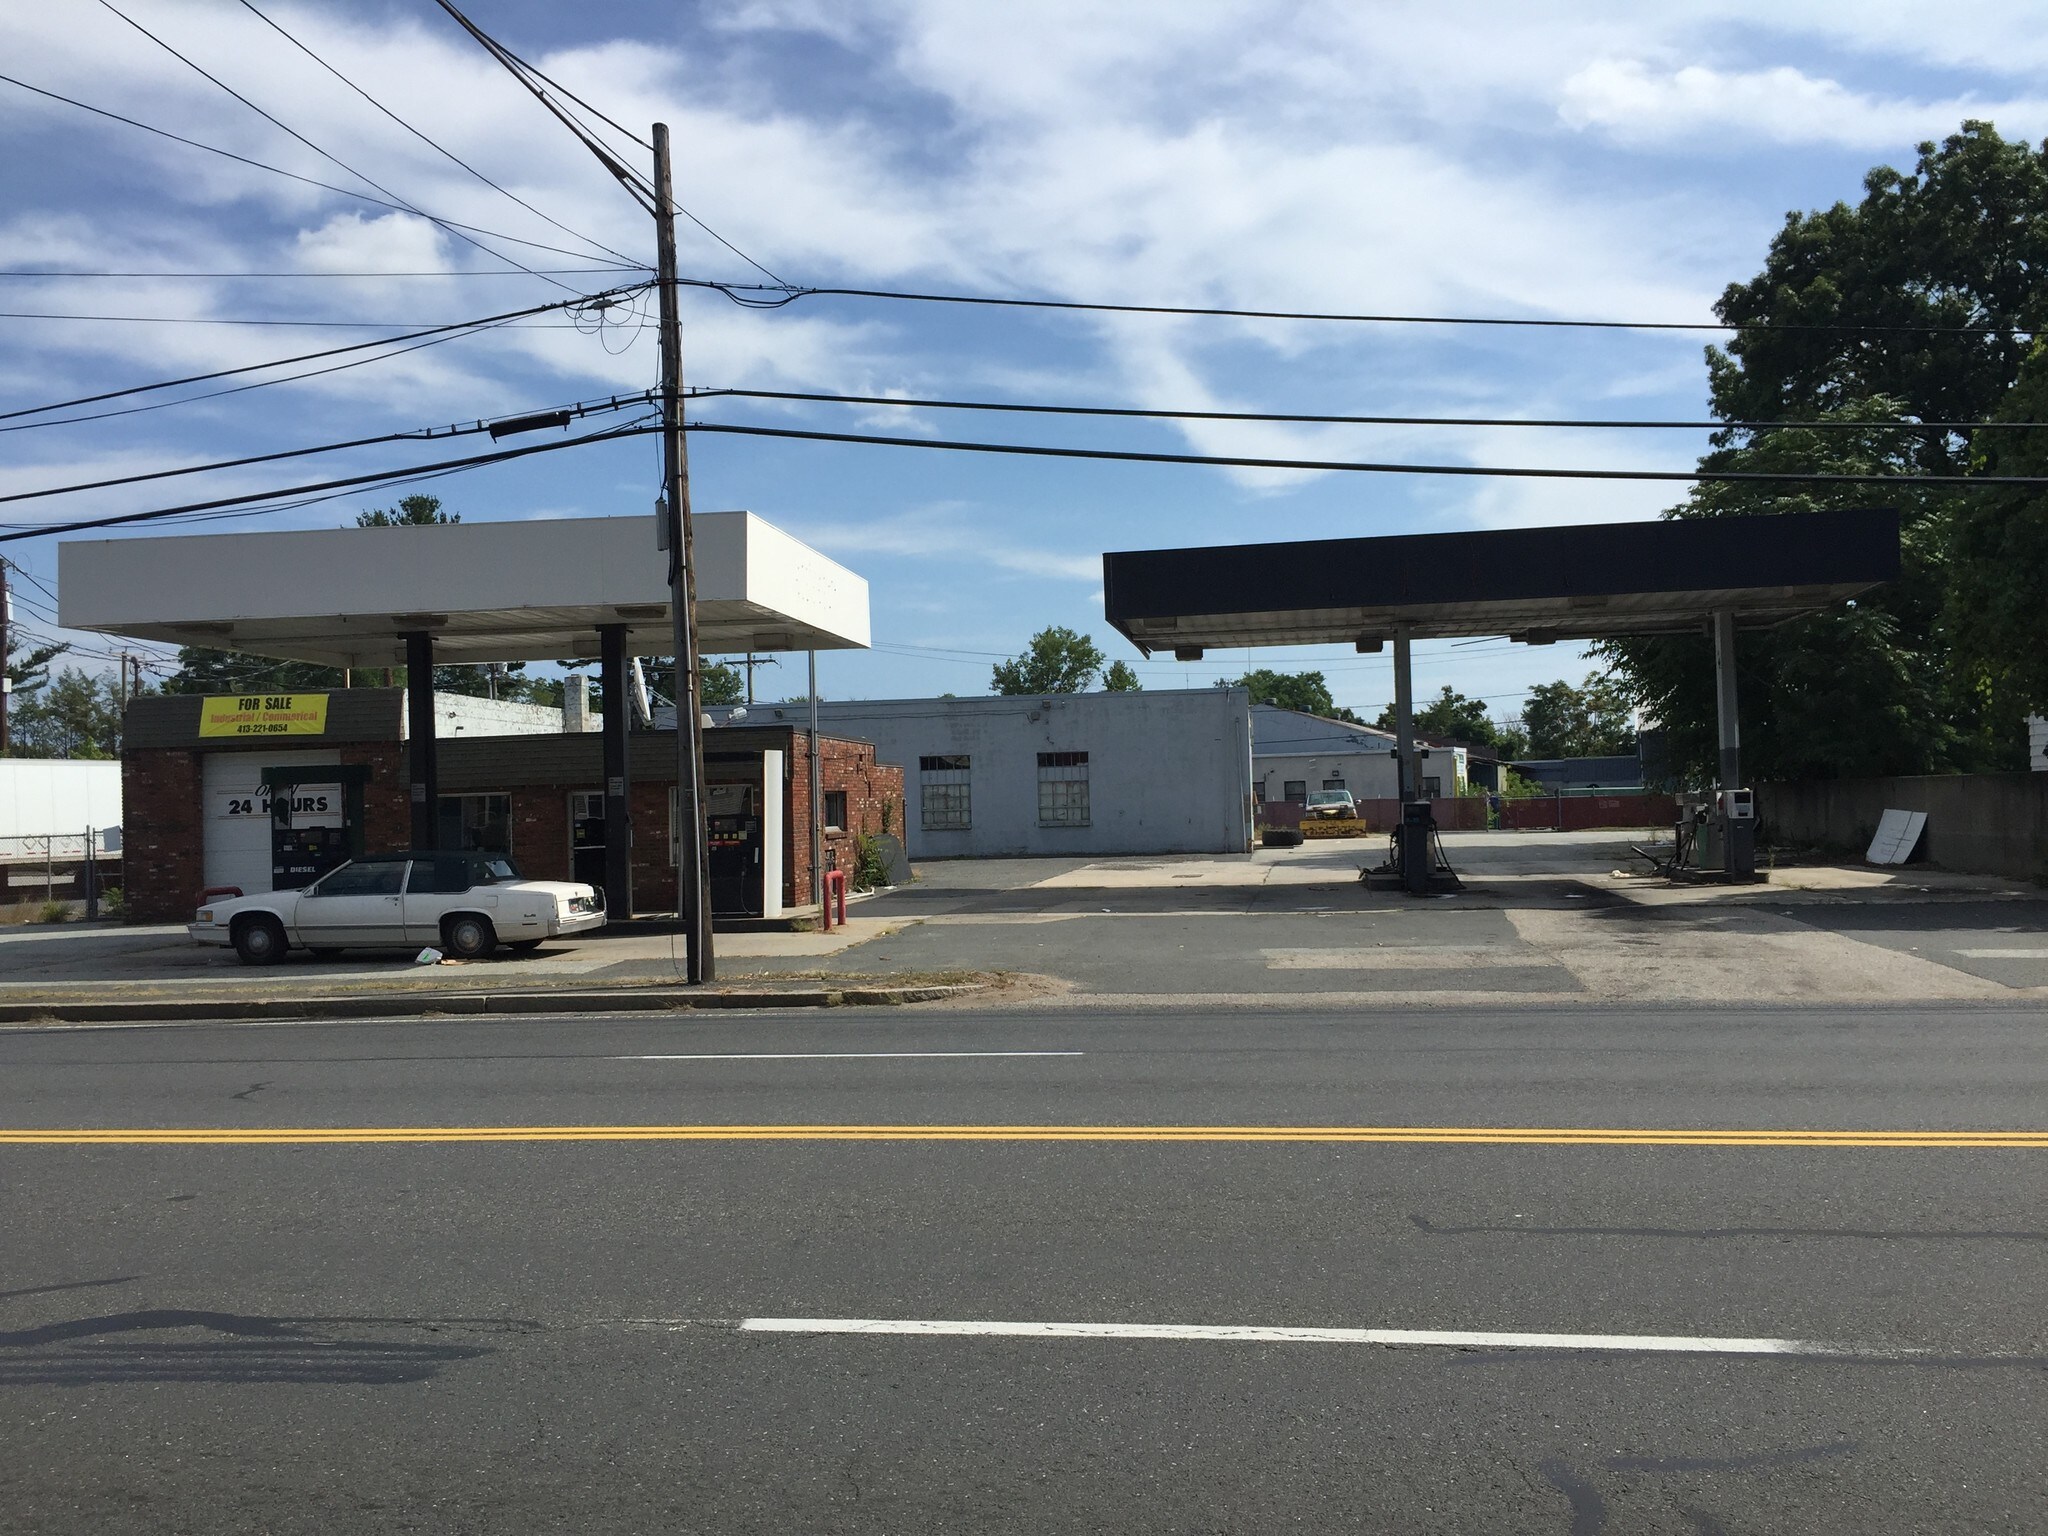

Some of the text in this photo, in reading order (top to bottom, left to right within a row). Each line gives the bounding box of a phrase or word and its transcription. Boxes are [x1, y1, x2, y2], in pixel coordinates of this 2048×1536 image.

[238, 697, 292, 711] FOR SALE
[237, 724, 288, 733] 413-221-0654
[228, 796, 328, 814] 24 HURS
